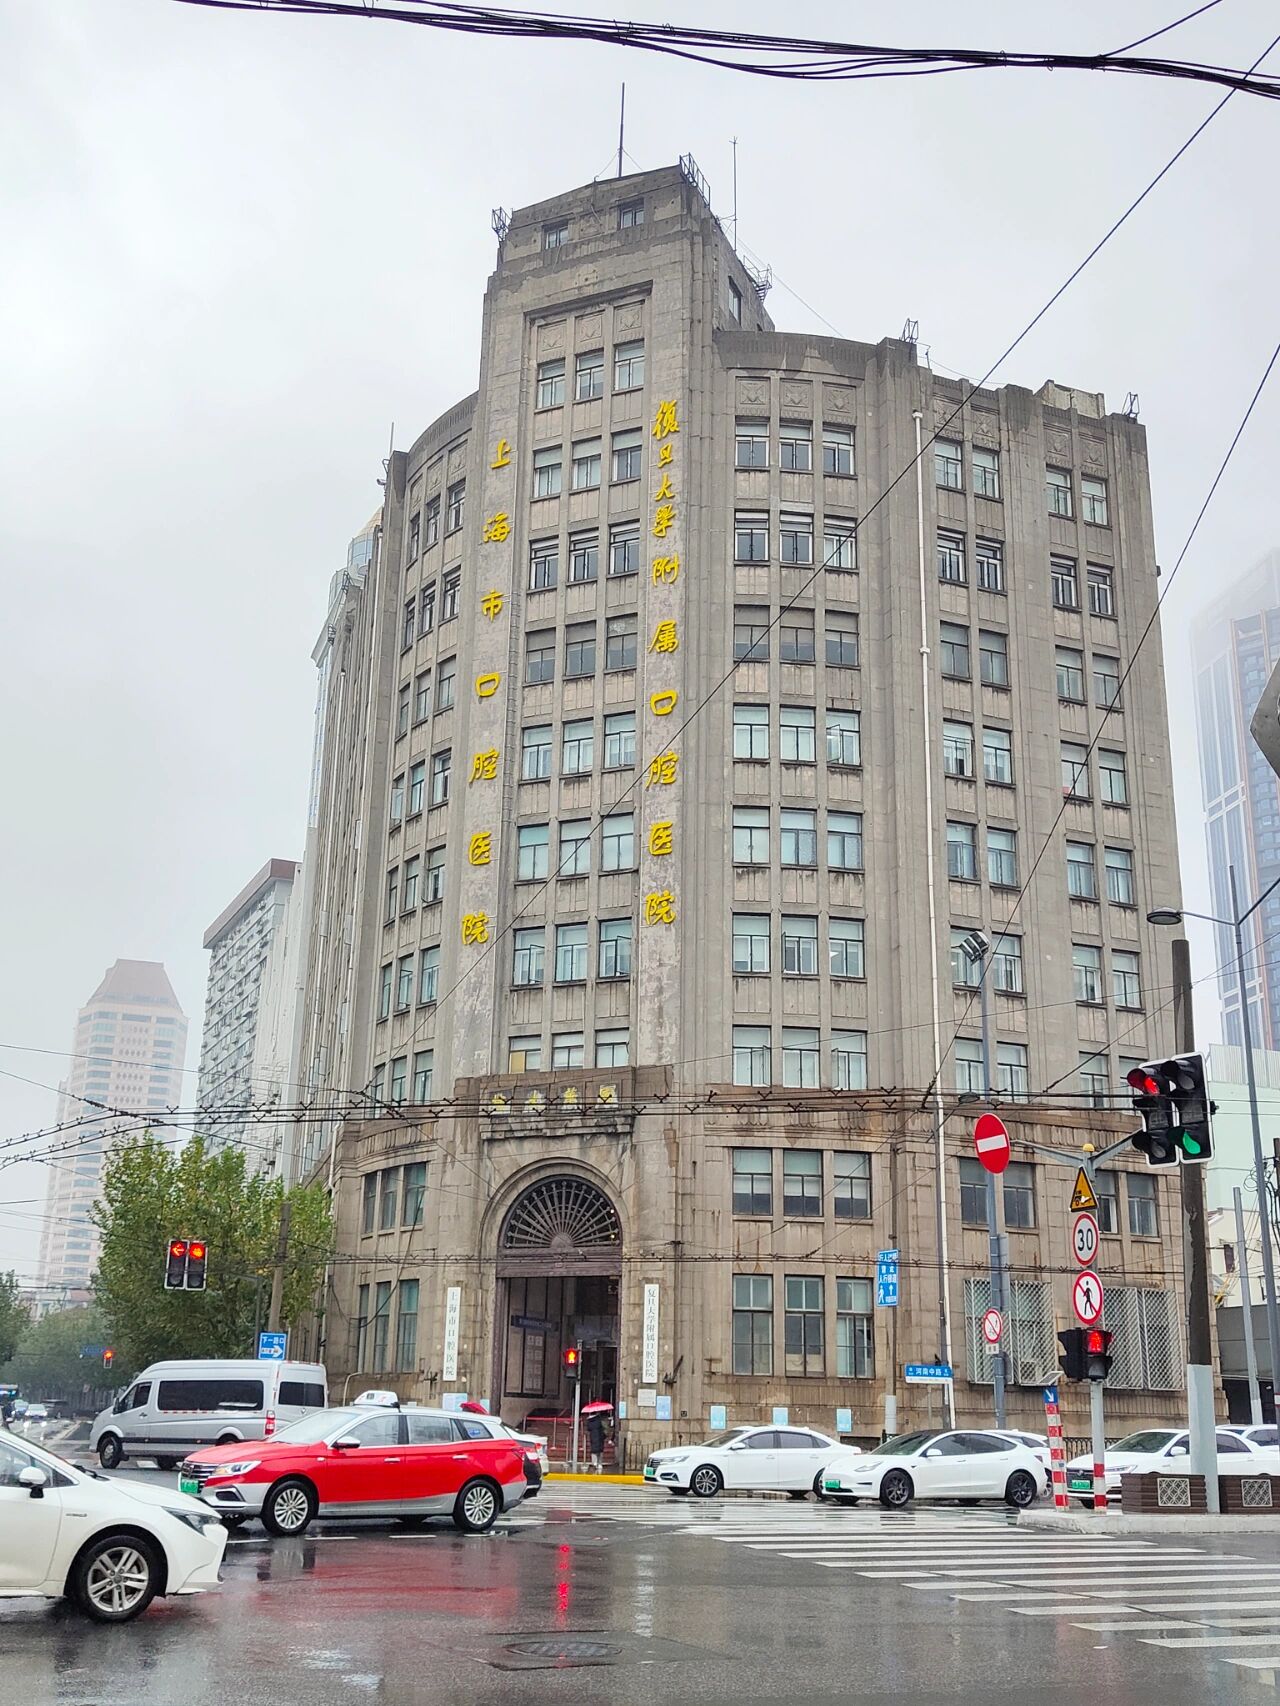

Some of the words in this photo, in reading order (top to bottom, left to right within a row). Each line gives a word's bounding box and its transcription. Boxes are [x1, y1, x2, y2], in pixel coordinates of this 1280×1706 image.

[461, 439, 511, 945] 上海市口腔医院
[1077, 1228, 1093, 1251] 30
